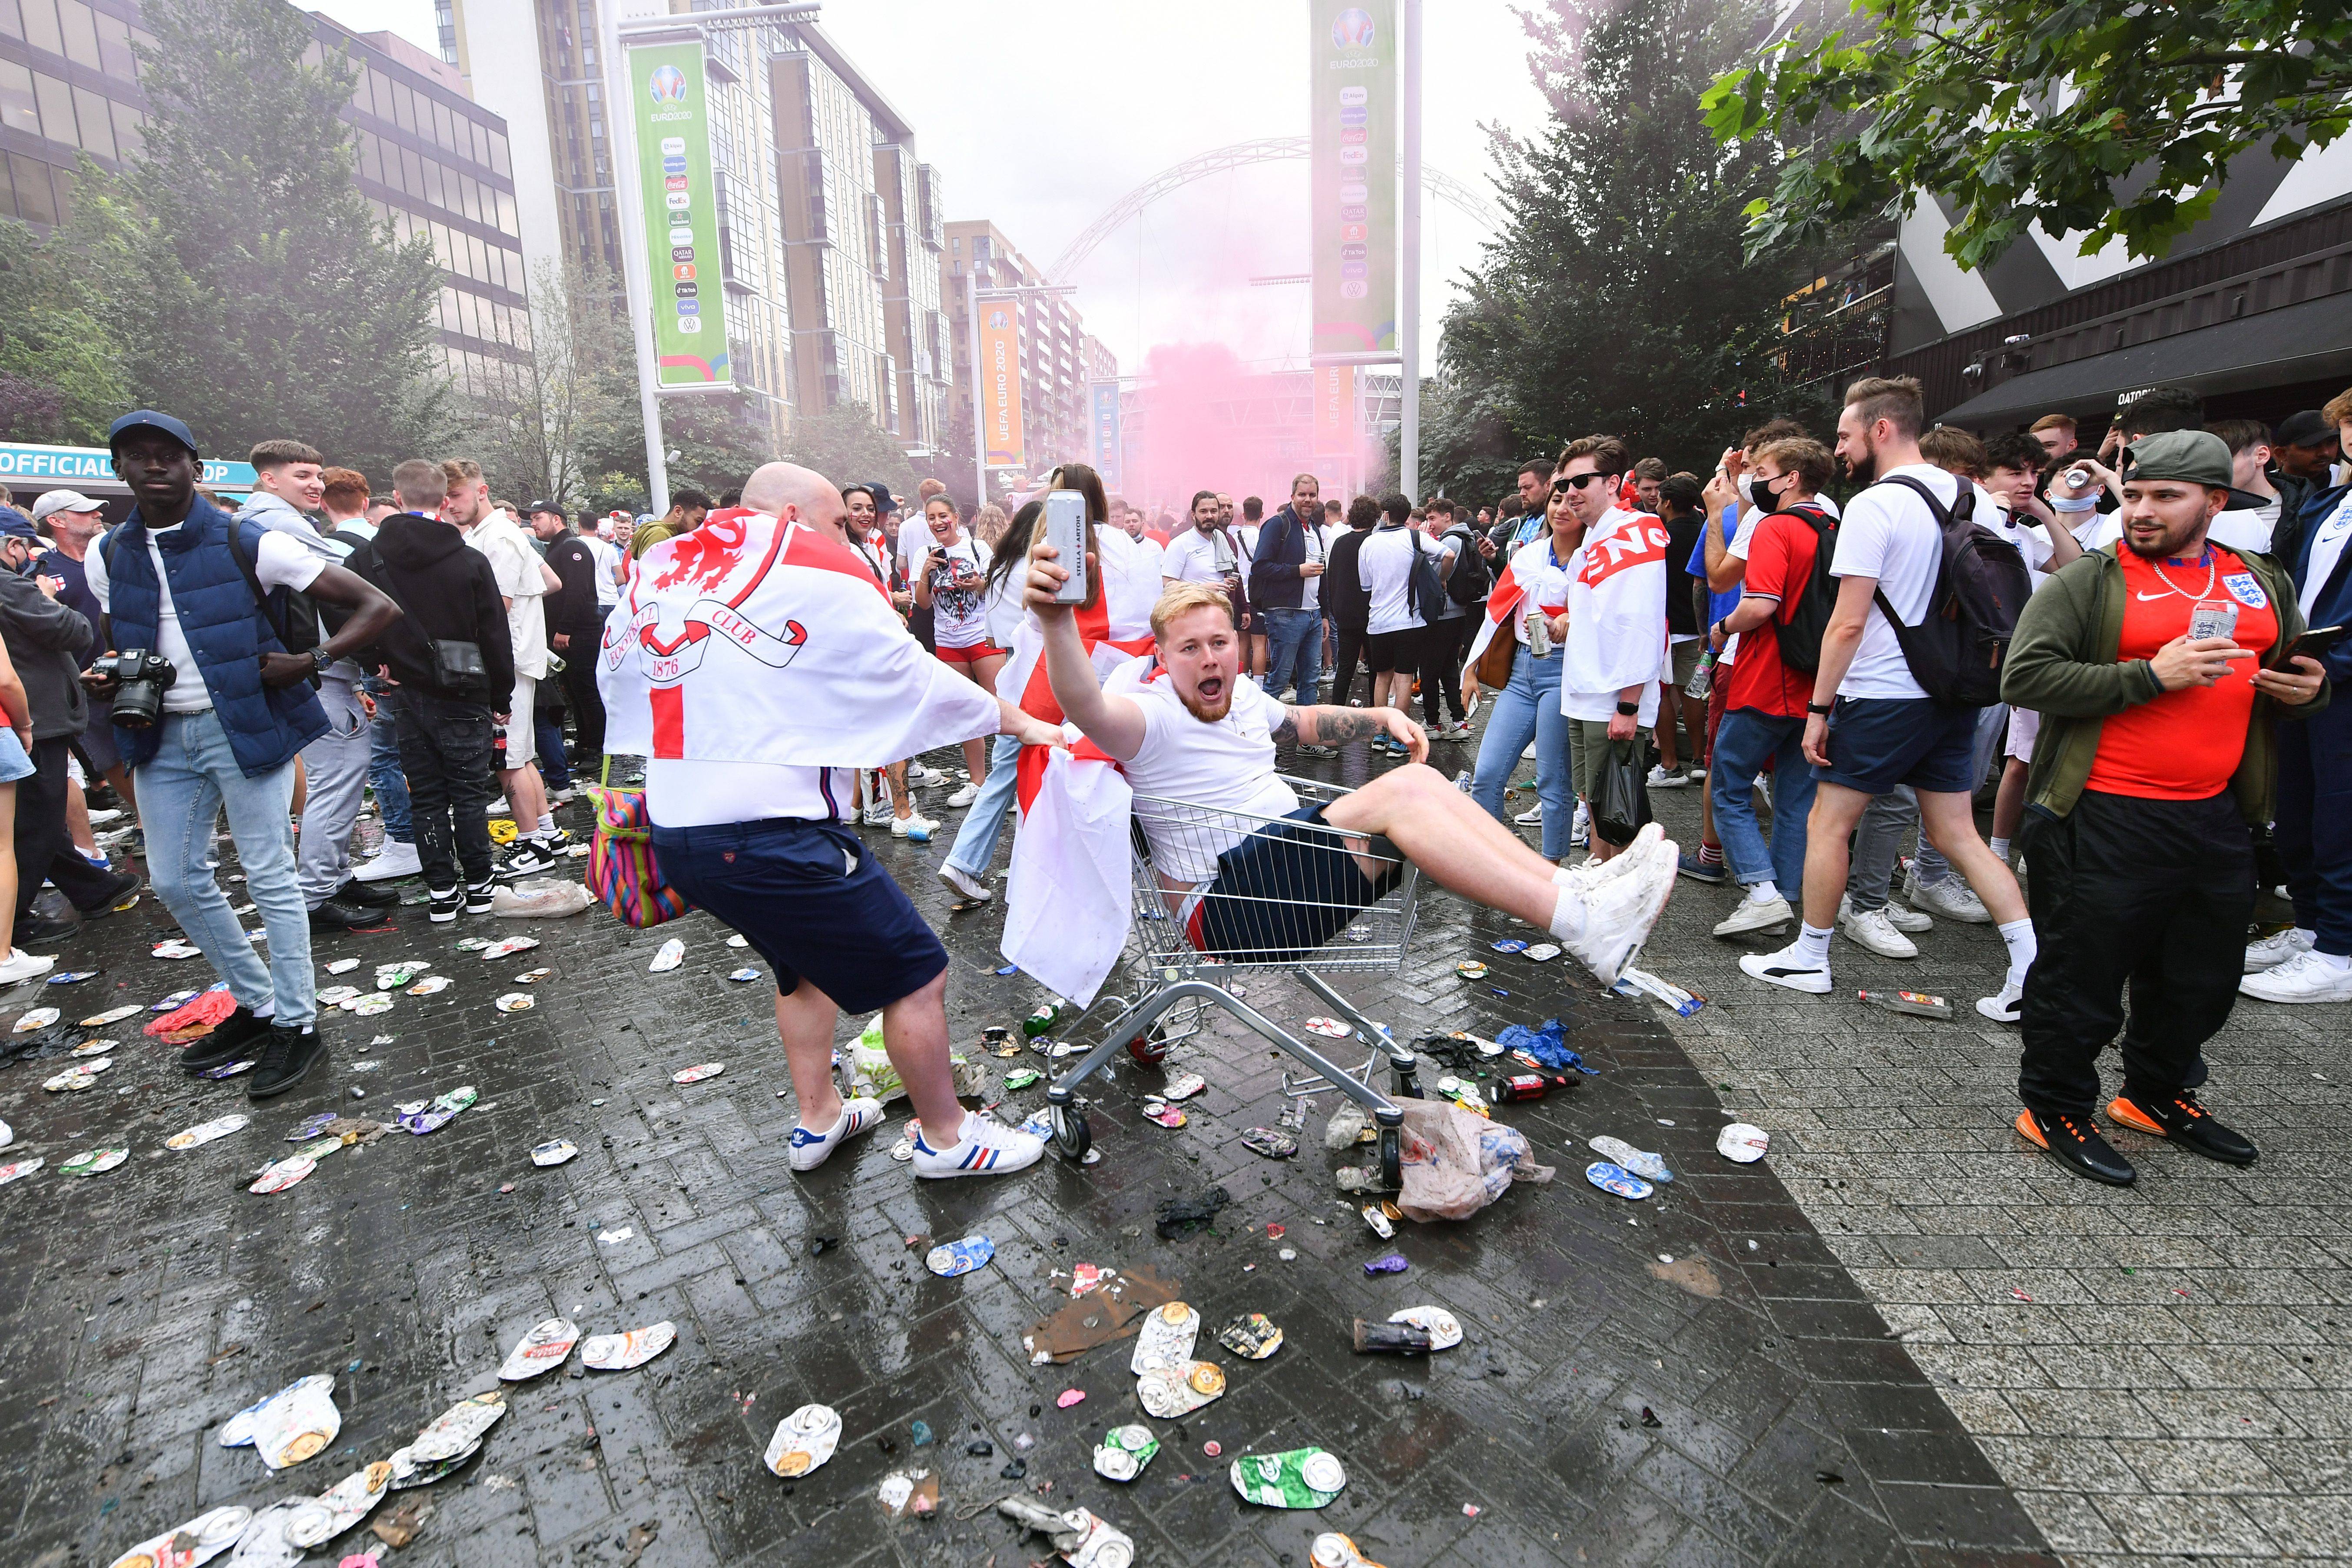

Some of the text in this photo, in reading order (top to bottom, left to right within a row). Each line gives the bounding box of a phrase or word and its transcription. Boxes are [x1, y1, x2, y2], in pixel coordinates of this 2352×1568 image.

[995, 341, 1009, 441] UEFA EURO 2020
[1329, 396, 1339, 428] UEFA
[0, 453, 113, 476] OFFICIAL
[712, 610, 756, 644] CLUB
[945, 616, 981, 632] England
[653, 658, 678, 677] 1876
